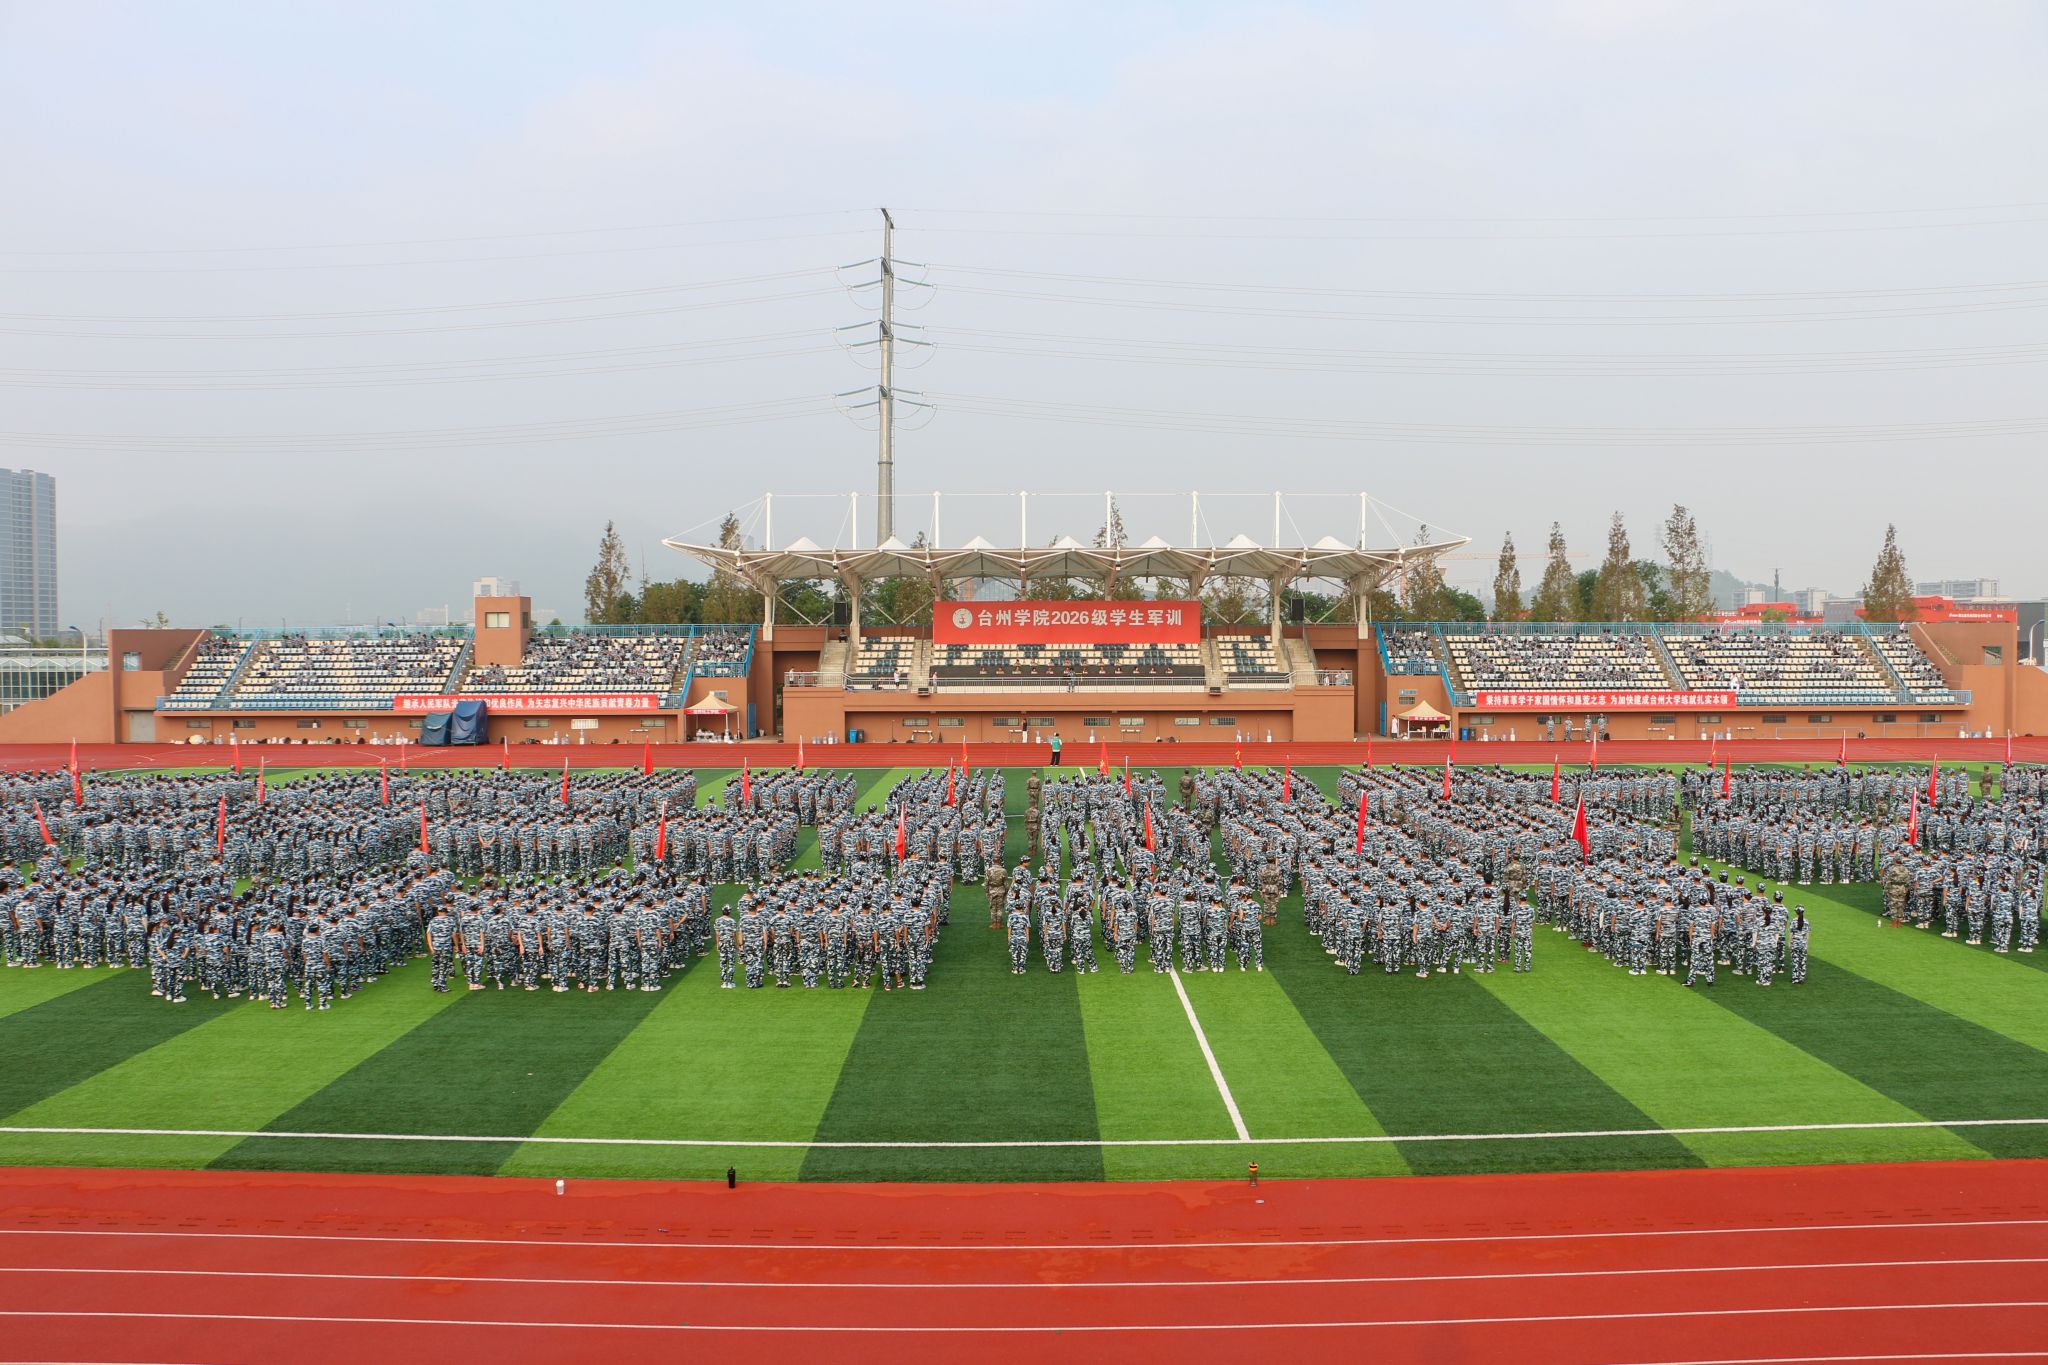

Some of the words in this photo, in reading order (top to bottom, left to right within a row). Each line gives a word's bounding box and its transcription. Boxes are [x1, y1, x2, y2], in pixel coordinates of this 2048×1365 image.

[978, 608, 1183, 626] 台州学院2026级学生军训
[1610, 695, 1729, 705] 为加快建成台州大学练就扎实本领
